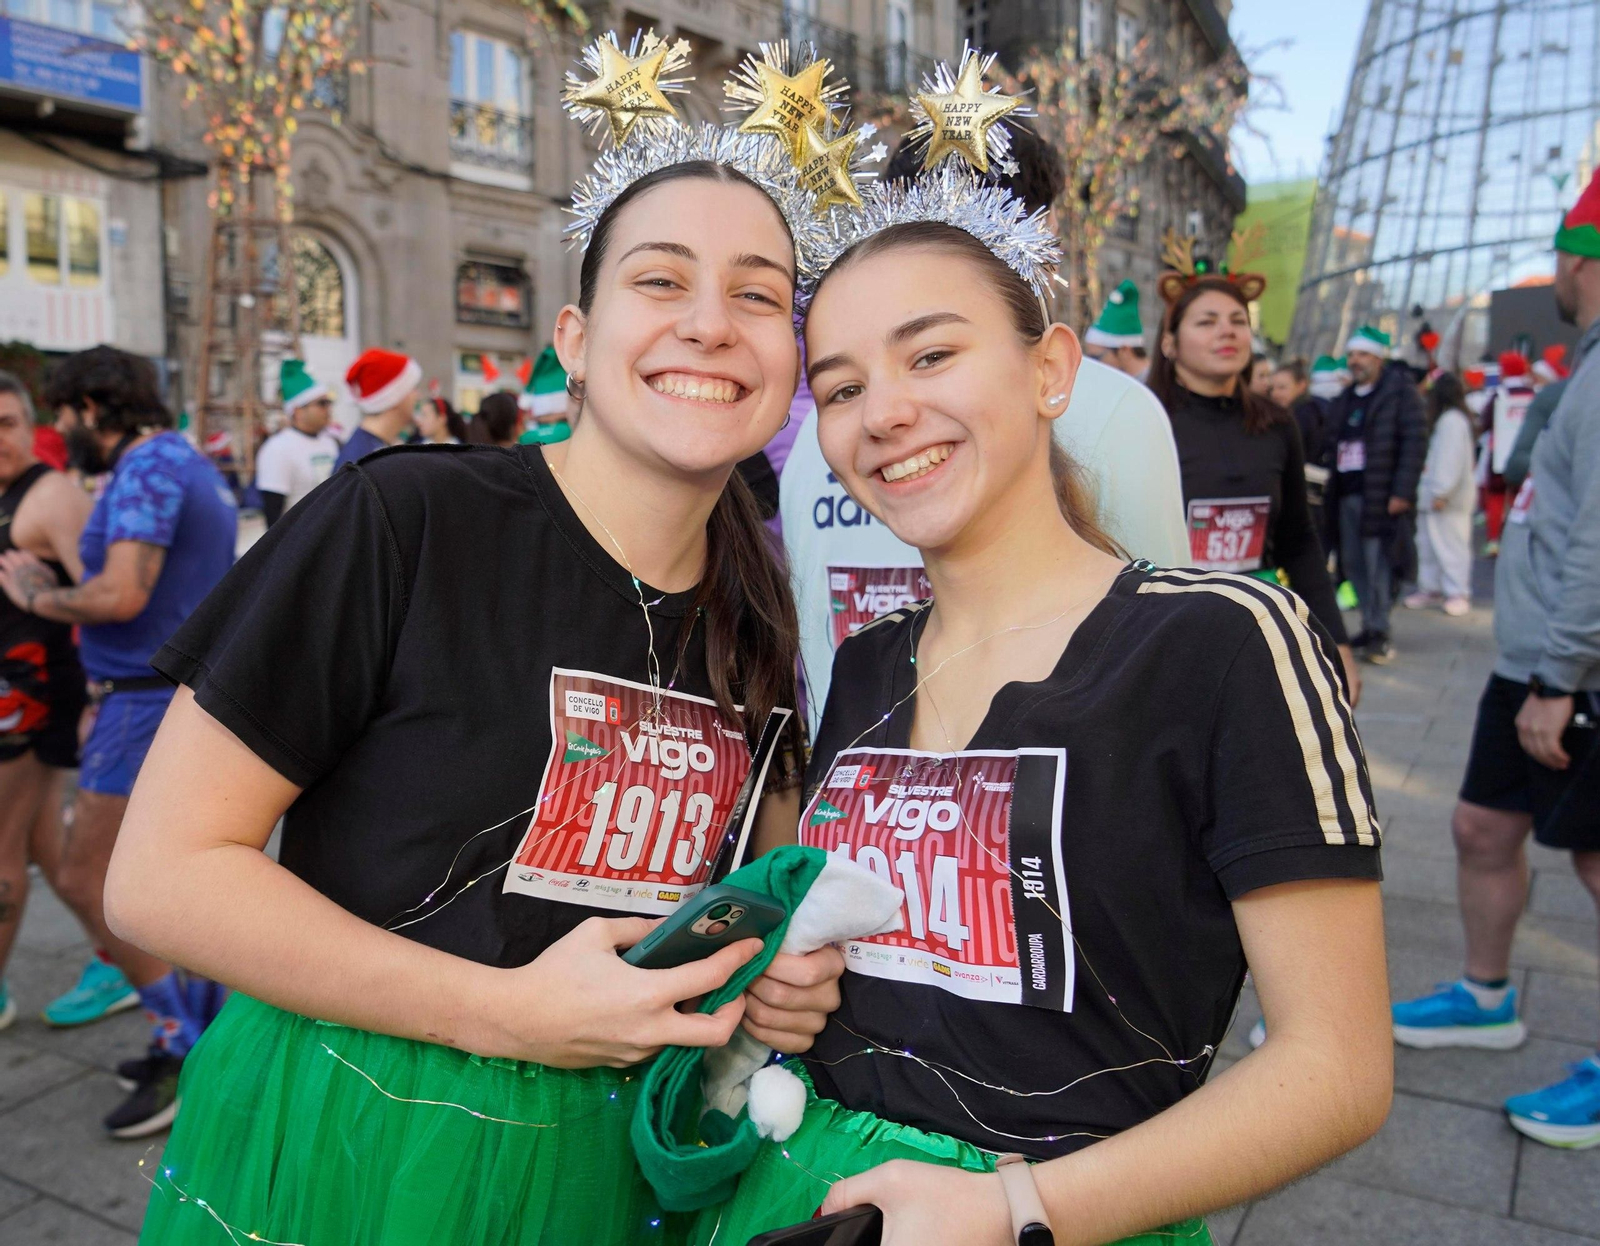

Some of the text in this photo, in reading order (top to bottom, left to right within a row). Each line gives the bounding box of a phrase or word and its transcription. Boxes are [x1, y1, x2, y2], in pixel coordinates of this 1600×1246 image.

[605, 67, 641, 94] HAPPY
[618, 81, 642, 101] NEW
[621, 91, 652, 109] YEAR
[780, 86, 816, 114] HAPPY
[779, 100, 805, 120] NEW
[942, 103, 982, 113] HAPPY
[771, 109, 800, 133] YEAR
[946, 116, 972, 126] NEW
[942, 130, 972, 140] YEAR
[802, 151, 831, 177] HAPPY
[810, 166, 829, 185] NEW
[813, 177, 837, 195] YEAR
[1206, 530, 1252, 560] 537
[568, 695, 604, 708] CONCELLO
[573, 704, 600, 715] DE VIGO
[639, 720, 703, 740] SILVESTRE
[888, 784, 954, 799] SILVESTRE
[578, 781, 715, 877] 1913
[1021, 856, 1046, 899] 1914
[832, 842, 970, 951] 14
[1028, 933, 1047, 990] GARDARROUPA
[954, 970, 981, 981] avanza
